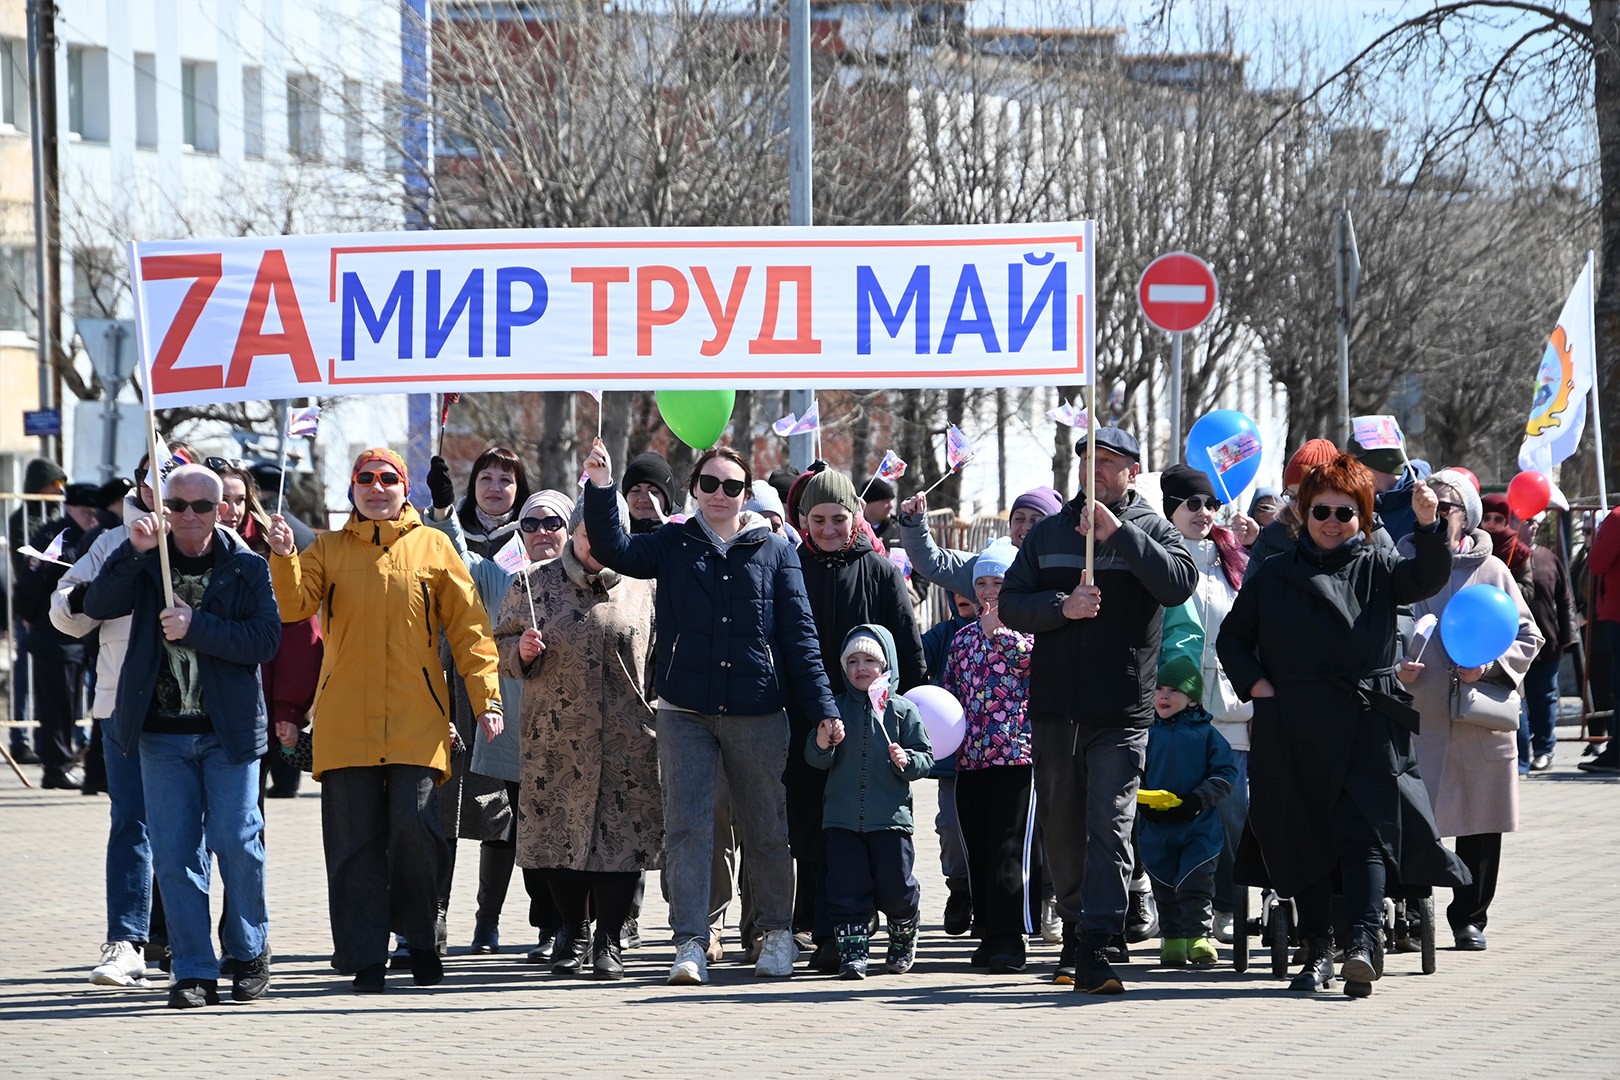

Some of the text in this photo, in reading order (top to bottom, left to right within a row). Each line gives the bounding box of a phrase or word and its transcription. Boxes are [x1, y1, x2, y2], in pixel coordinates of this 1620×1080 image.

[341, 267, 548, 361] МИР
[572, 266, 821, 357] ТРУД
[857, 252, 1067, 356] МАЙ
